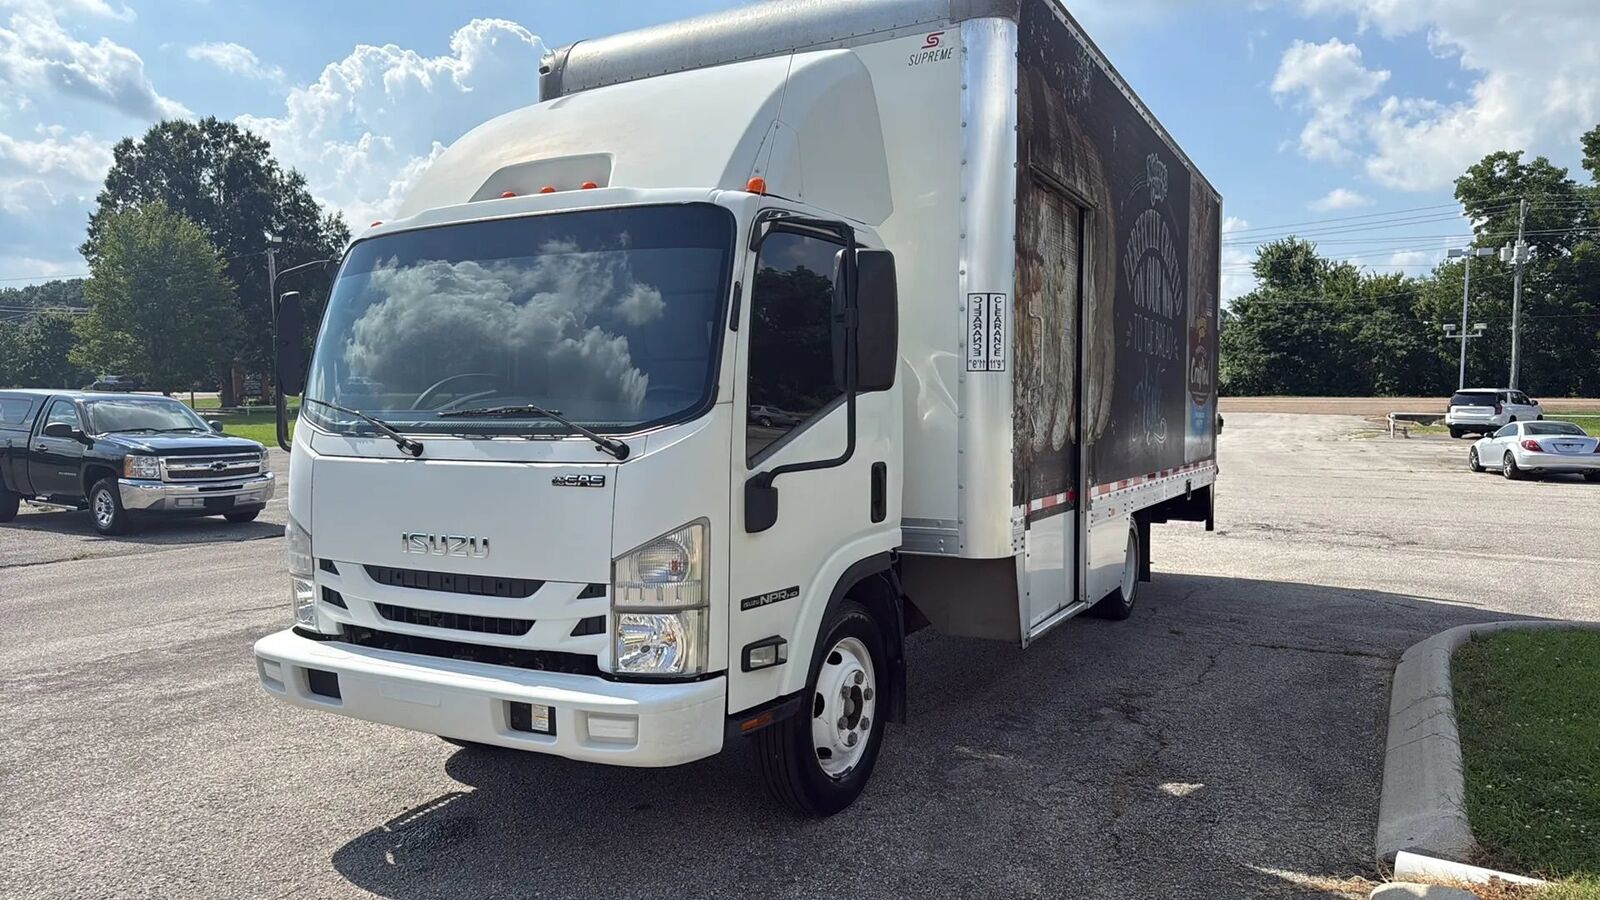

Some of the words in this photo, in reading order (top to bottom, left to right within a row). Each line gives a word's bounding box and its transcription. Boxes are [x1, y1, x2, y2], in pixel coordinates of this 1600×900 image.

[908, 47, 954, 66] SUPREME
[994, 296, 1002, 357] CLEARANCE
[565, 474, 604, 487] GAS
[402, 532, 489, 558] ISUZU
